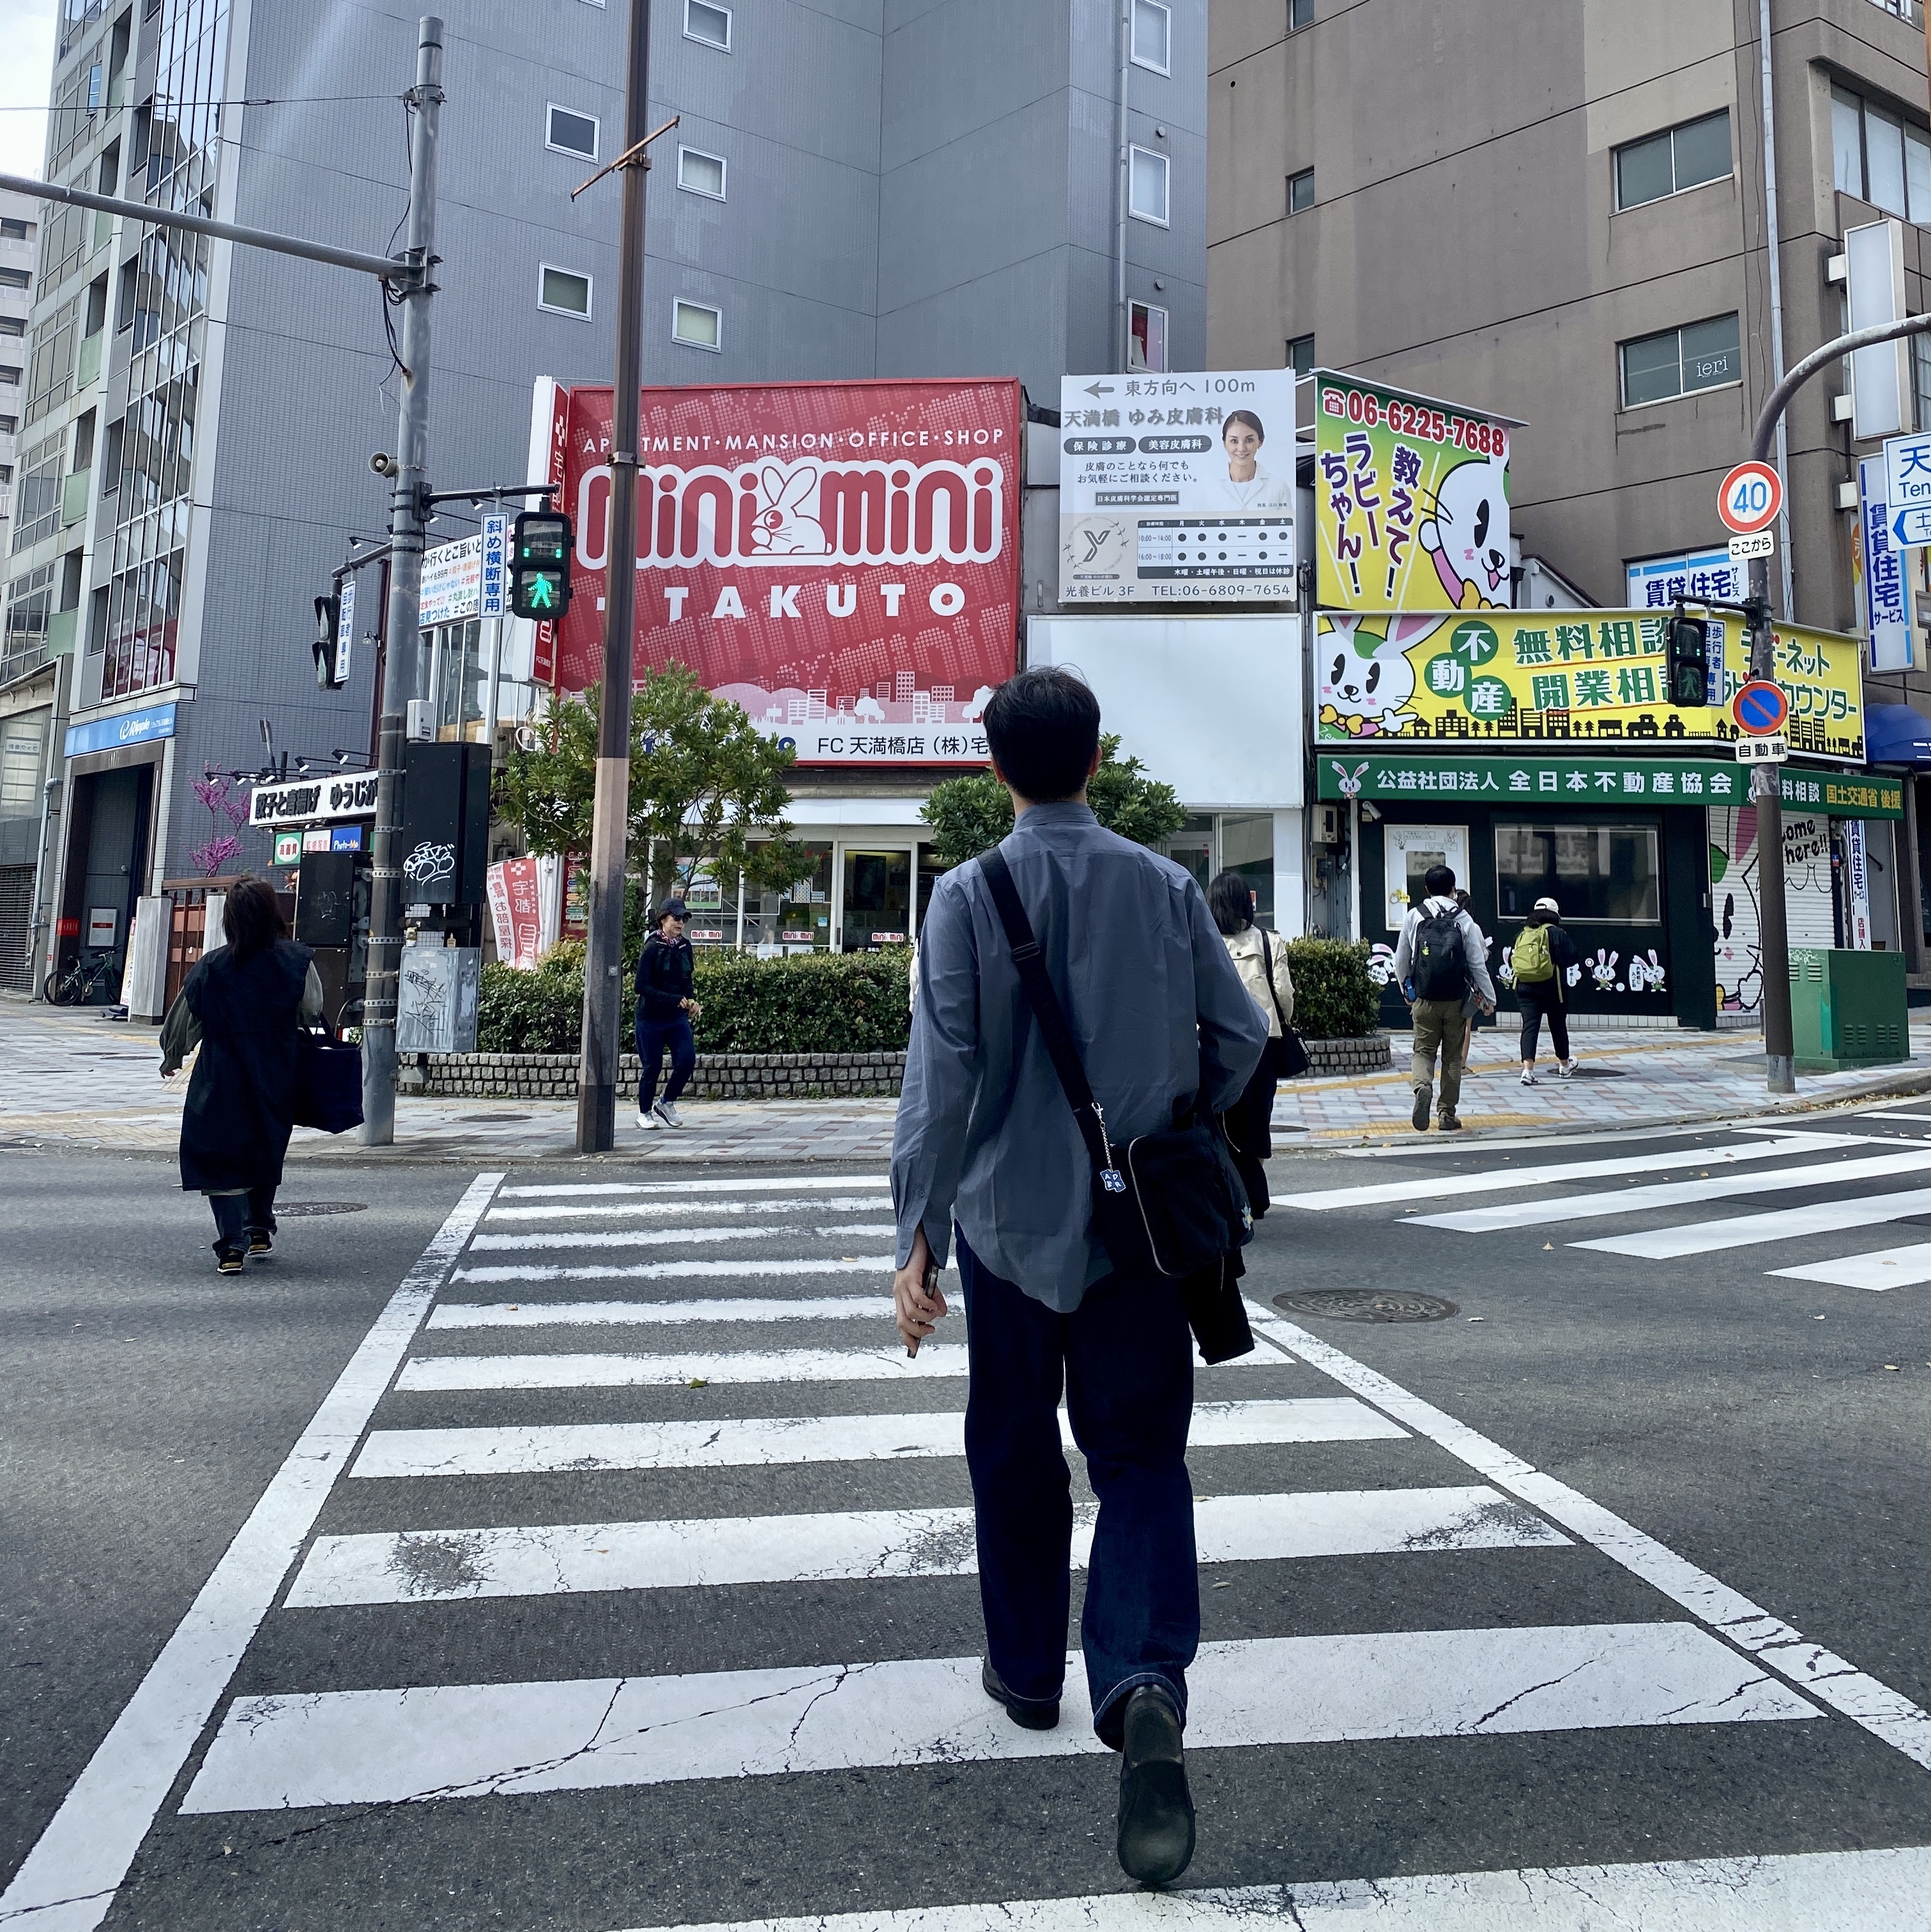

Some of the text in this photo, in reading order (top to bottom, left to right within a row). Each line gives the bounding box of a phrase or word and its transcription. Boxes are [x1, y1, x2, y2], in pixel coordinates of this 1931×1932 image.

[1697, 356, 1729, 377] ieri
[1125, 378, 1255, 396] 東方向へ 100m
[1064, 406, 1225, 427] 天満橋 ゆみ皮膚科
[1348, 391, 1504, 457] 06-6225-7688
[583, 427, 1004, 453] APTMENT MANSION OFFICE SHOP
[1073, 440, 1127, 452] 保険診療
[1148, 439, 1203, 450] 美容皮膚科
[1077, 473, 1198, 483] お気軽にご相談ください。
[1085, 460, 1189, 471] 皮膚のことなら何でも
[1344, 433, 1380, 547] ラビー
[1733, 481, 1767, 513] 40
[1320, 452, 1361, 594] ちゃん！
[1385, 445, 1422, 598] 教えて！
[1731, 537, 1772, 556] ここから
[484, 519, 503, 613] 斜め横断専用
[1118, 585, 1136, 597] 3F
[1151, 584, 1291, 597] TEL:06-6809-7654
[1645, 570, 1732, 608] 賃貸住宅
[1730, 567, 1741, 597] サービス
[663, 583, 966, 622] TAKUTO
[1874, 608, 1904, 626] サービス
[1712, 625, 1723, 670] 歩行者
[1531, 666, 1668, 714] 開業相
[818, 737, 844, 753] FC
[850, 736, 926, 755] 天満橋店
[1739, 743, 1786, 758] 自動車
[1377, 770, 1732, 795] 公益社団法人 全日本不動産協会
[254, 785, 322, 820] 餃子と唐揚げ
[1826, 784, 1878, 808] 国土交通省
[1880, 790, 1902, 810] 後援
[333, 839, 360, 850] Photo-Me
[1785, 833, 1829, 865] here!!
